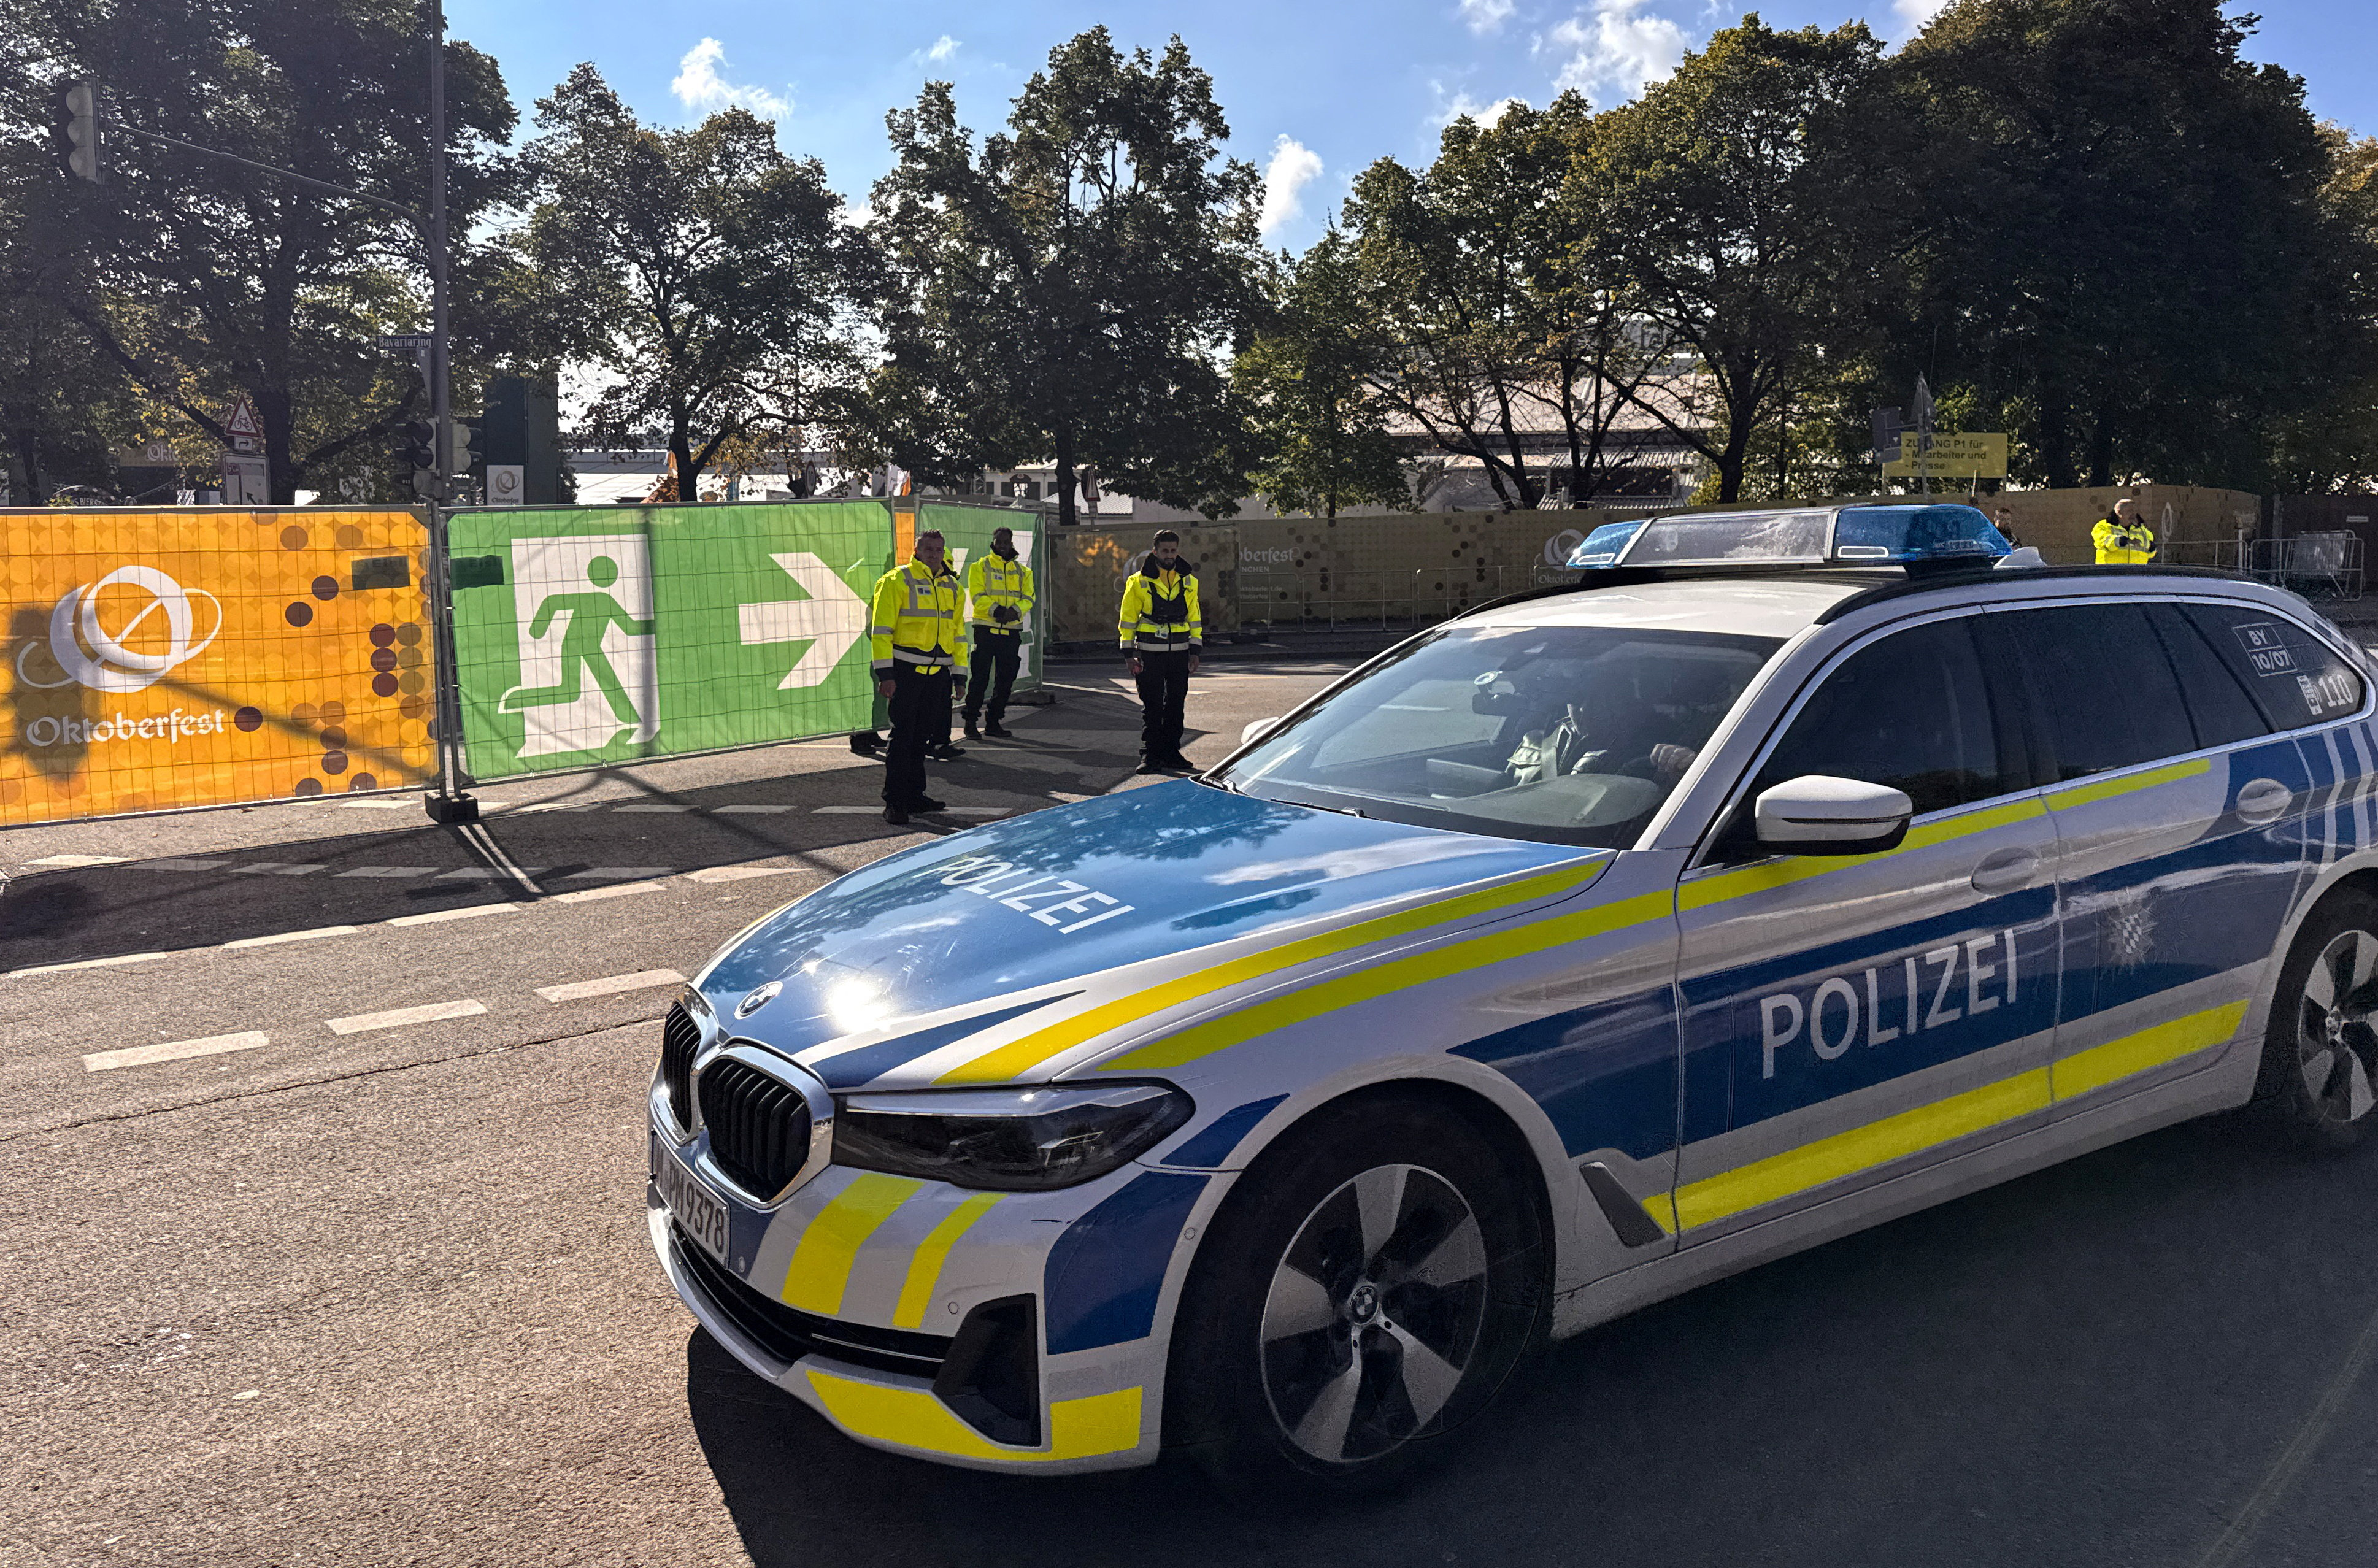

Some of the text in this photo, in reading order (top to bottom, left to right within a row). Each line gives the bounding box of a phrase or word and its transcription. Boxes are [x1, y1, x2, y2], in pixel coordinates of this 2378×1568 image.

[379, 337, 432, 348] Bavariaring
[1906, 439, 1983, 448] ZUNG P1 für
[1912, 450, 1965, 459] Marbeiter
[2248, 629, 2268, 645] BY
[2252, 650, 2290, 670] 10/07
[2318, 674, 2353, 707] 110
[26, 708, 225, 747] Oktoberfest
[912, 856, 1136, 934] POLIZEI
[1760, 928, 2017, 1079] POLIZEI
